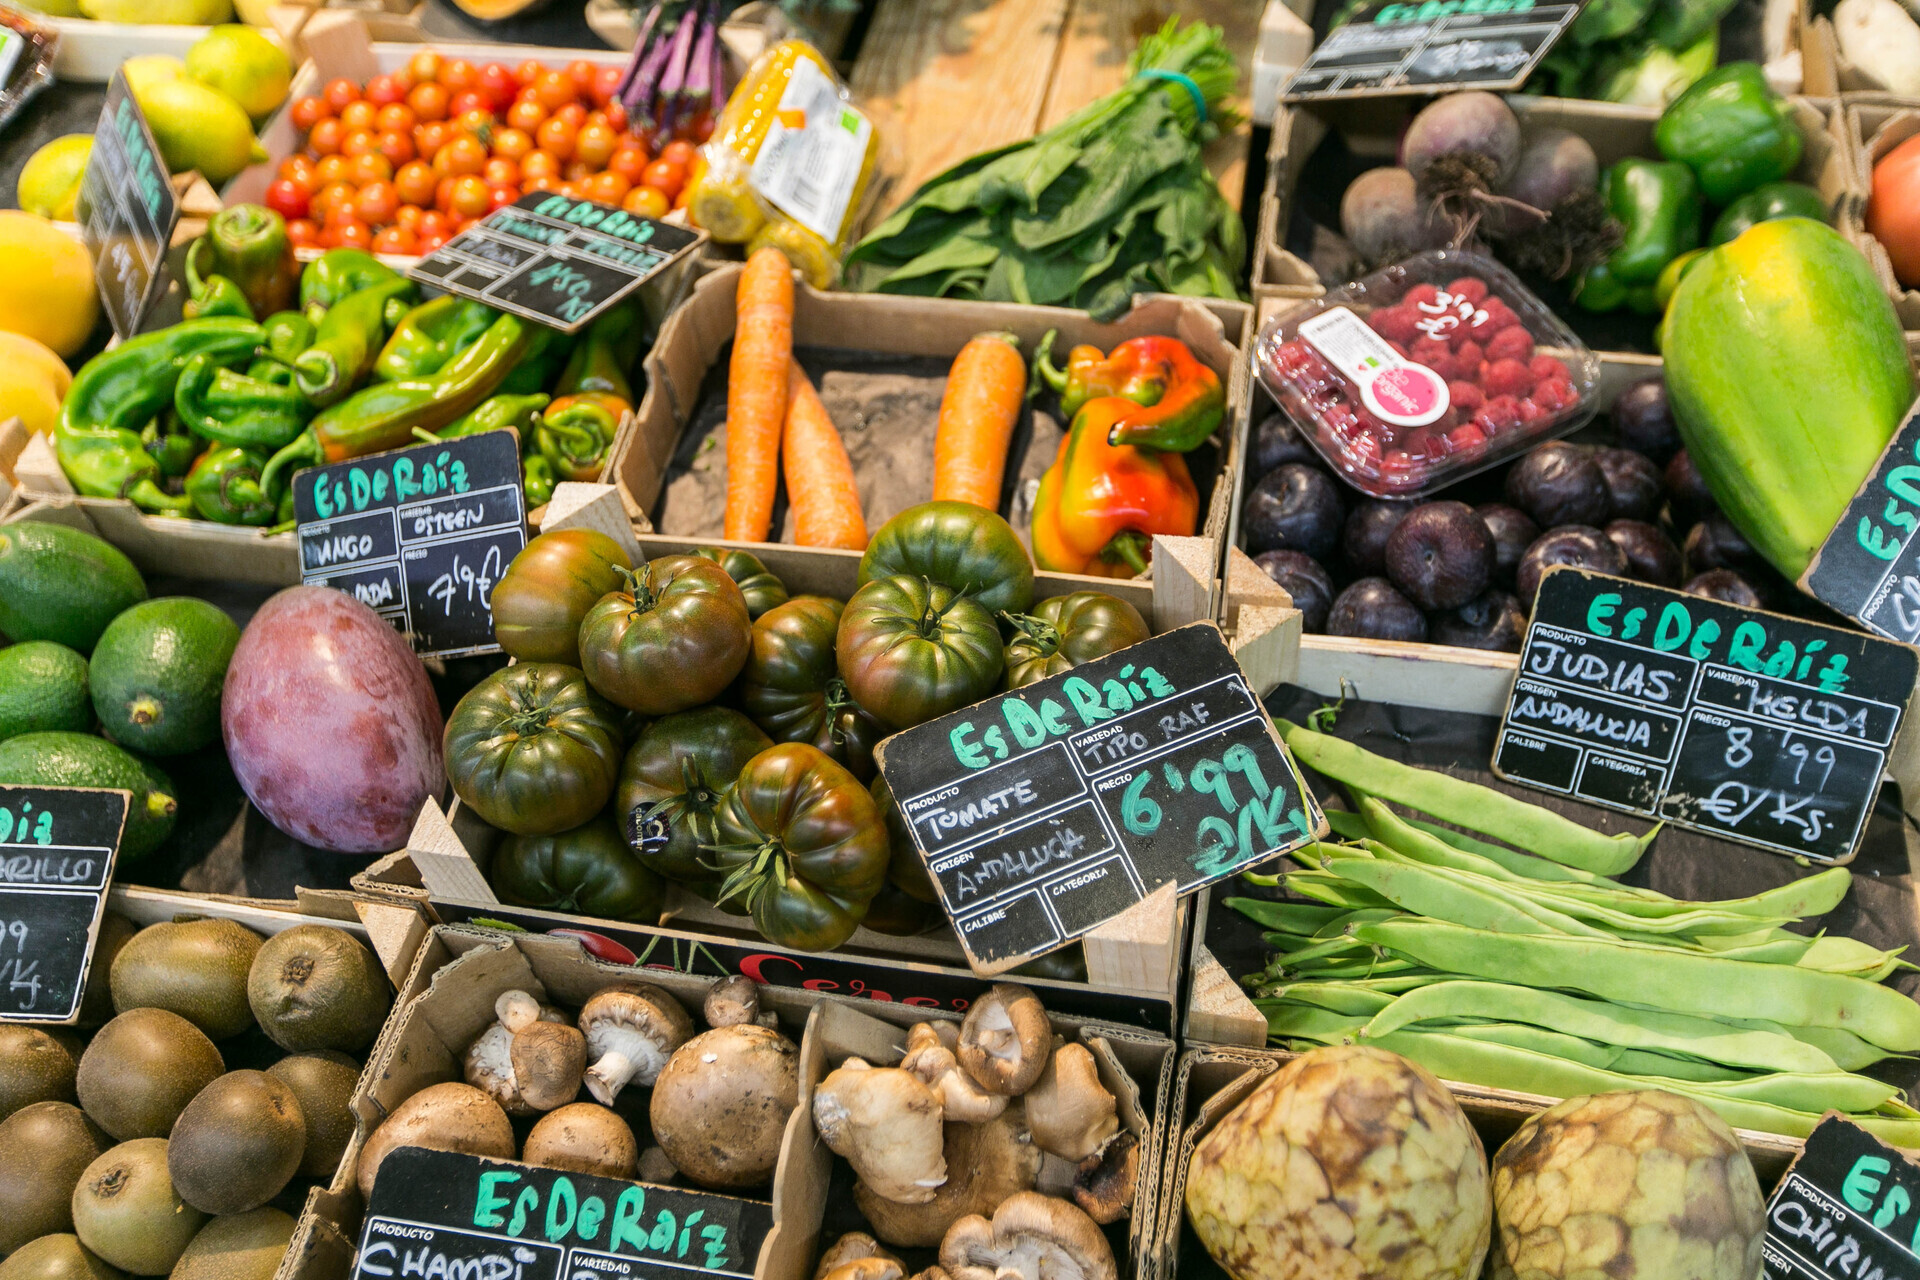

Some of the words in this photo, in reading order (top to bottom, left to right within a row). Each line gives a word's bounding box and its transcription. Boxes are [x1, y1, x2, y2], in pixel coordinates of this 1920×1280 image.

[414, 503, 485, 537] OSTEEN
[1865, 573, 1898, 620] PRODUCTO
[1535, 626, 1587, 646] PRODUCTO
[1531, 641, 1676, 702] JUDIAS
[1706, 668, 1760, 689] VARIEDAD
[1519, 682, 1558, 698] ORIGEN
[1693, 711, 1732, 728] PRECIO
[1074, 725, 1124, 748] VARIEDAD
[1083, 732, 1149, 764] TIPO
[1158, 702, 1210, 740] RAF
[1506, 734, 1547, 752] CALIBRE
[1591, 756, 1647, 777] CATEGORIA
[1097, 773, 1133, 793] PRECIO
[907, 786, 960, 812] PRODUCTO
[914, 779, 1038, 840] TOMATE
[0, 854, 96, 883] RILLO
[935, 851, 975, 873] ORIGEN
[1052, 867, 1110, 896] CATEGORIA
[964, 909, 1007, 933] CALIBRE
[1789, 1179, 1847, 1222] PRODUCTO
[372, 1221, 435, 1241] PRODUCTO
[573, 1255, 632, 1275] VARIEDAD
